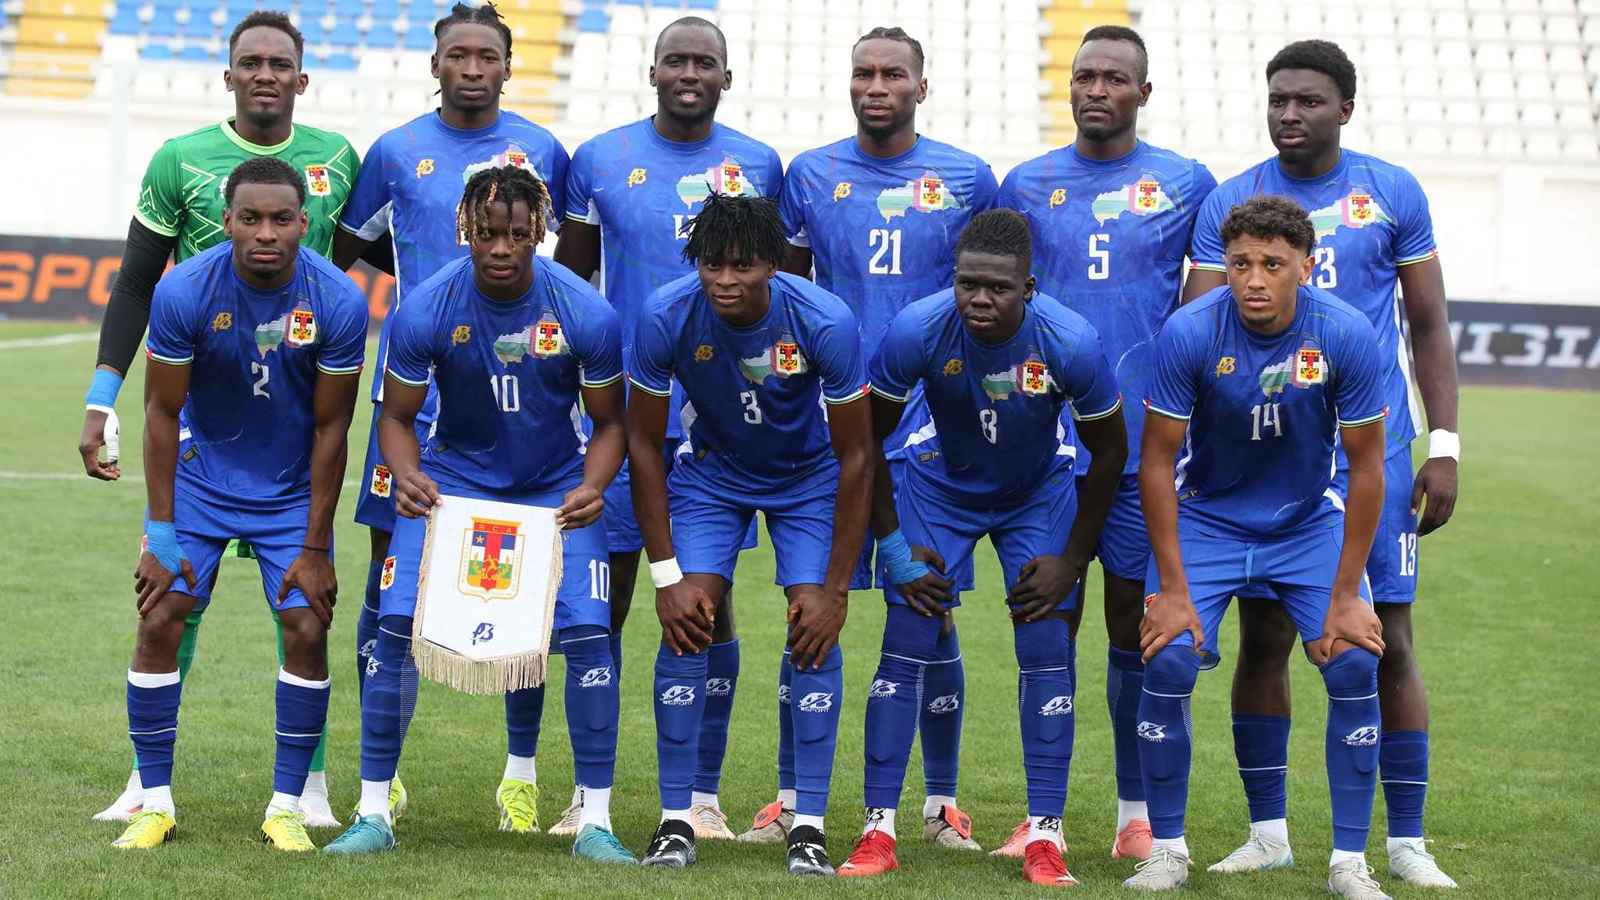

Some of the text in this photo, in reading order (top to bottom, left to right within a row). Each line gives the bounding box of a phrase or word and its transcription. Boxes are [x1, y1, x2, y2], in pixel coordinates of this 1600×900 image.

[868, 228, 902, 274] 21
[1088, 233, 1110, 280] 5
[1310, 247, 1337, 289] 3
[251, 361, 270, 399] 2
[490, 374, 520, 412] 10
[740, 390, 762, 424] 3
[979, 409, 998, 444] 8
[1251, 402, 1283, 440] 14
[1398, 532, 1417, 576] 13
[588, 559, 610, 602] 10
